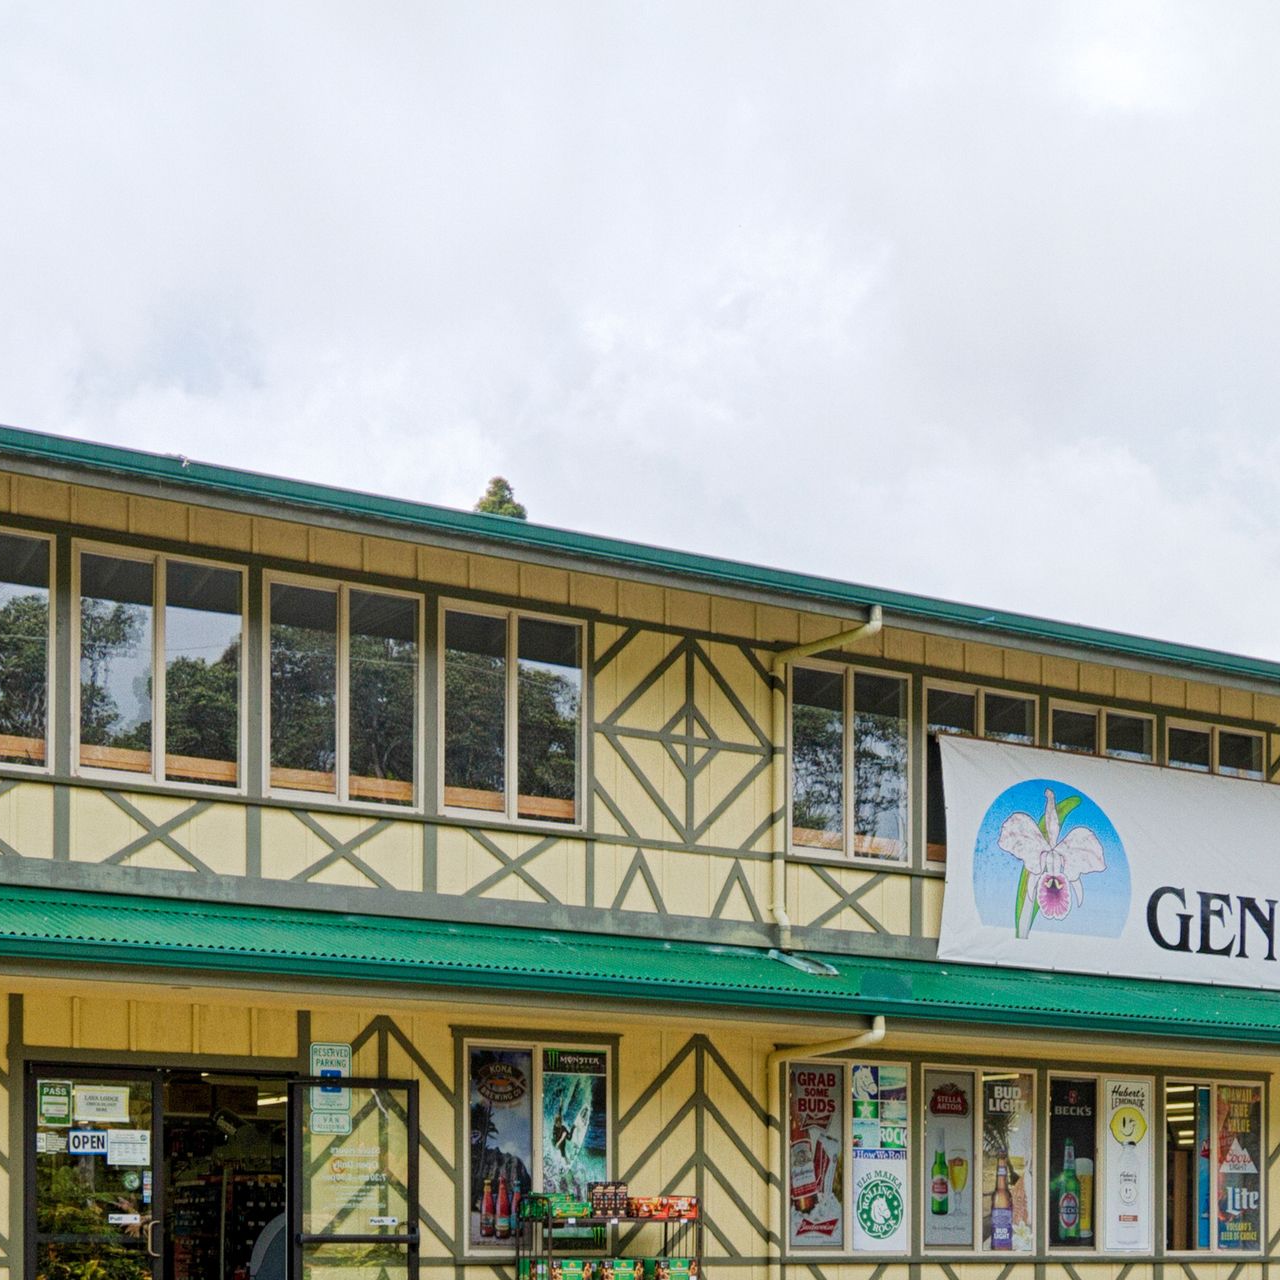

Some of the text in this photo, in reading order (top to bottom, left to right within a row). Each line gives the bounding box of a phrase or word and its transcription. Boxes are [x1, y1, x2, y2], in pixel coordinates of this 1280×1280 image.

[313, 1047, 349, 1058] RESERVED
[316, 1059, 347, 1068] PARKING
[560, 1055, 600, 1065] MONSTER
[489, 1064, 512, 1074] KONA
[797, 1072, 836, 1088] GRAB
[43, 1087, 67, 1095] PASS
[480, 1086, 513, 1100] BREWING
[804, 1088, 829, 1098] SOME
[994, 1086, 1022, 1099] BUD
[1112, 1085, 1145, 1098] Hubert's
[937, 1095, 962, 1103] STELLA
[1112, 1097, 1145, 1111] LEMONADE
[798, 1099, 836, 1113] BUDS
[1055, 1105, 1092, 1116] BECK'S
[72, 1135, 105, 1149] OPEN
[880, 1127, 907, 1147] ROCK
[856, 1170, 902, 1189] ULU MAIKA
[862, 1186, 893, 1209] ROLLING
[1225, 1186, 1259, 1215] Lite
[872, 1217, 896, 1233] ROCK
